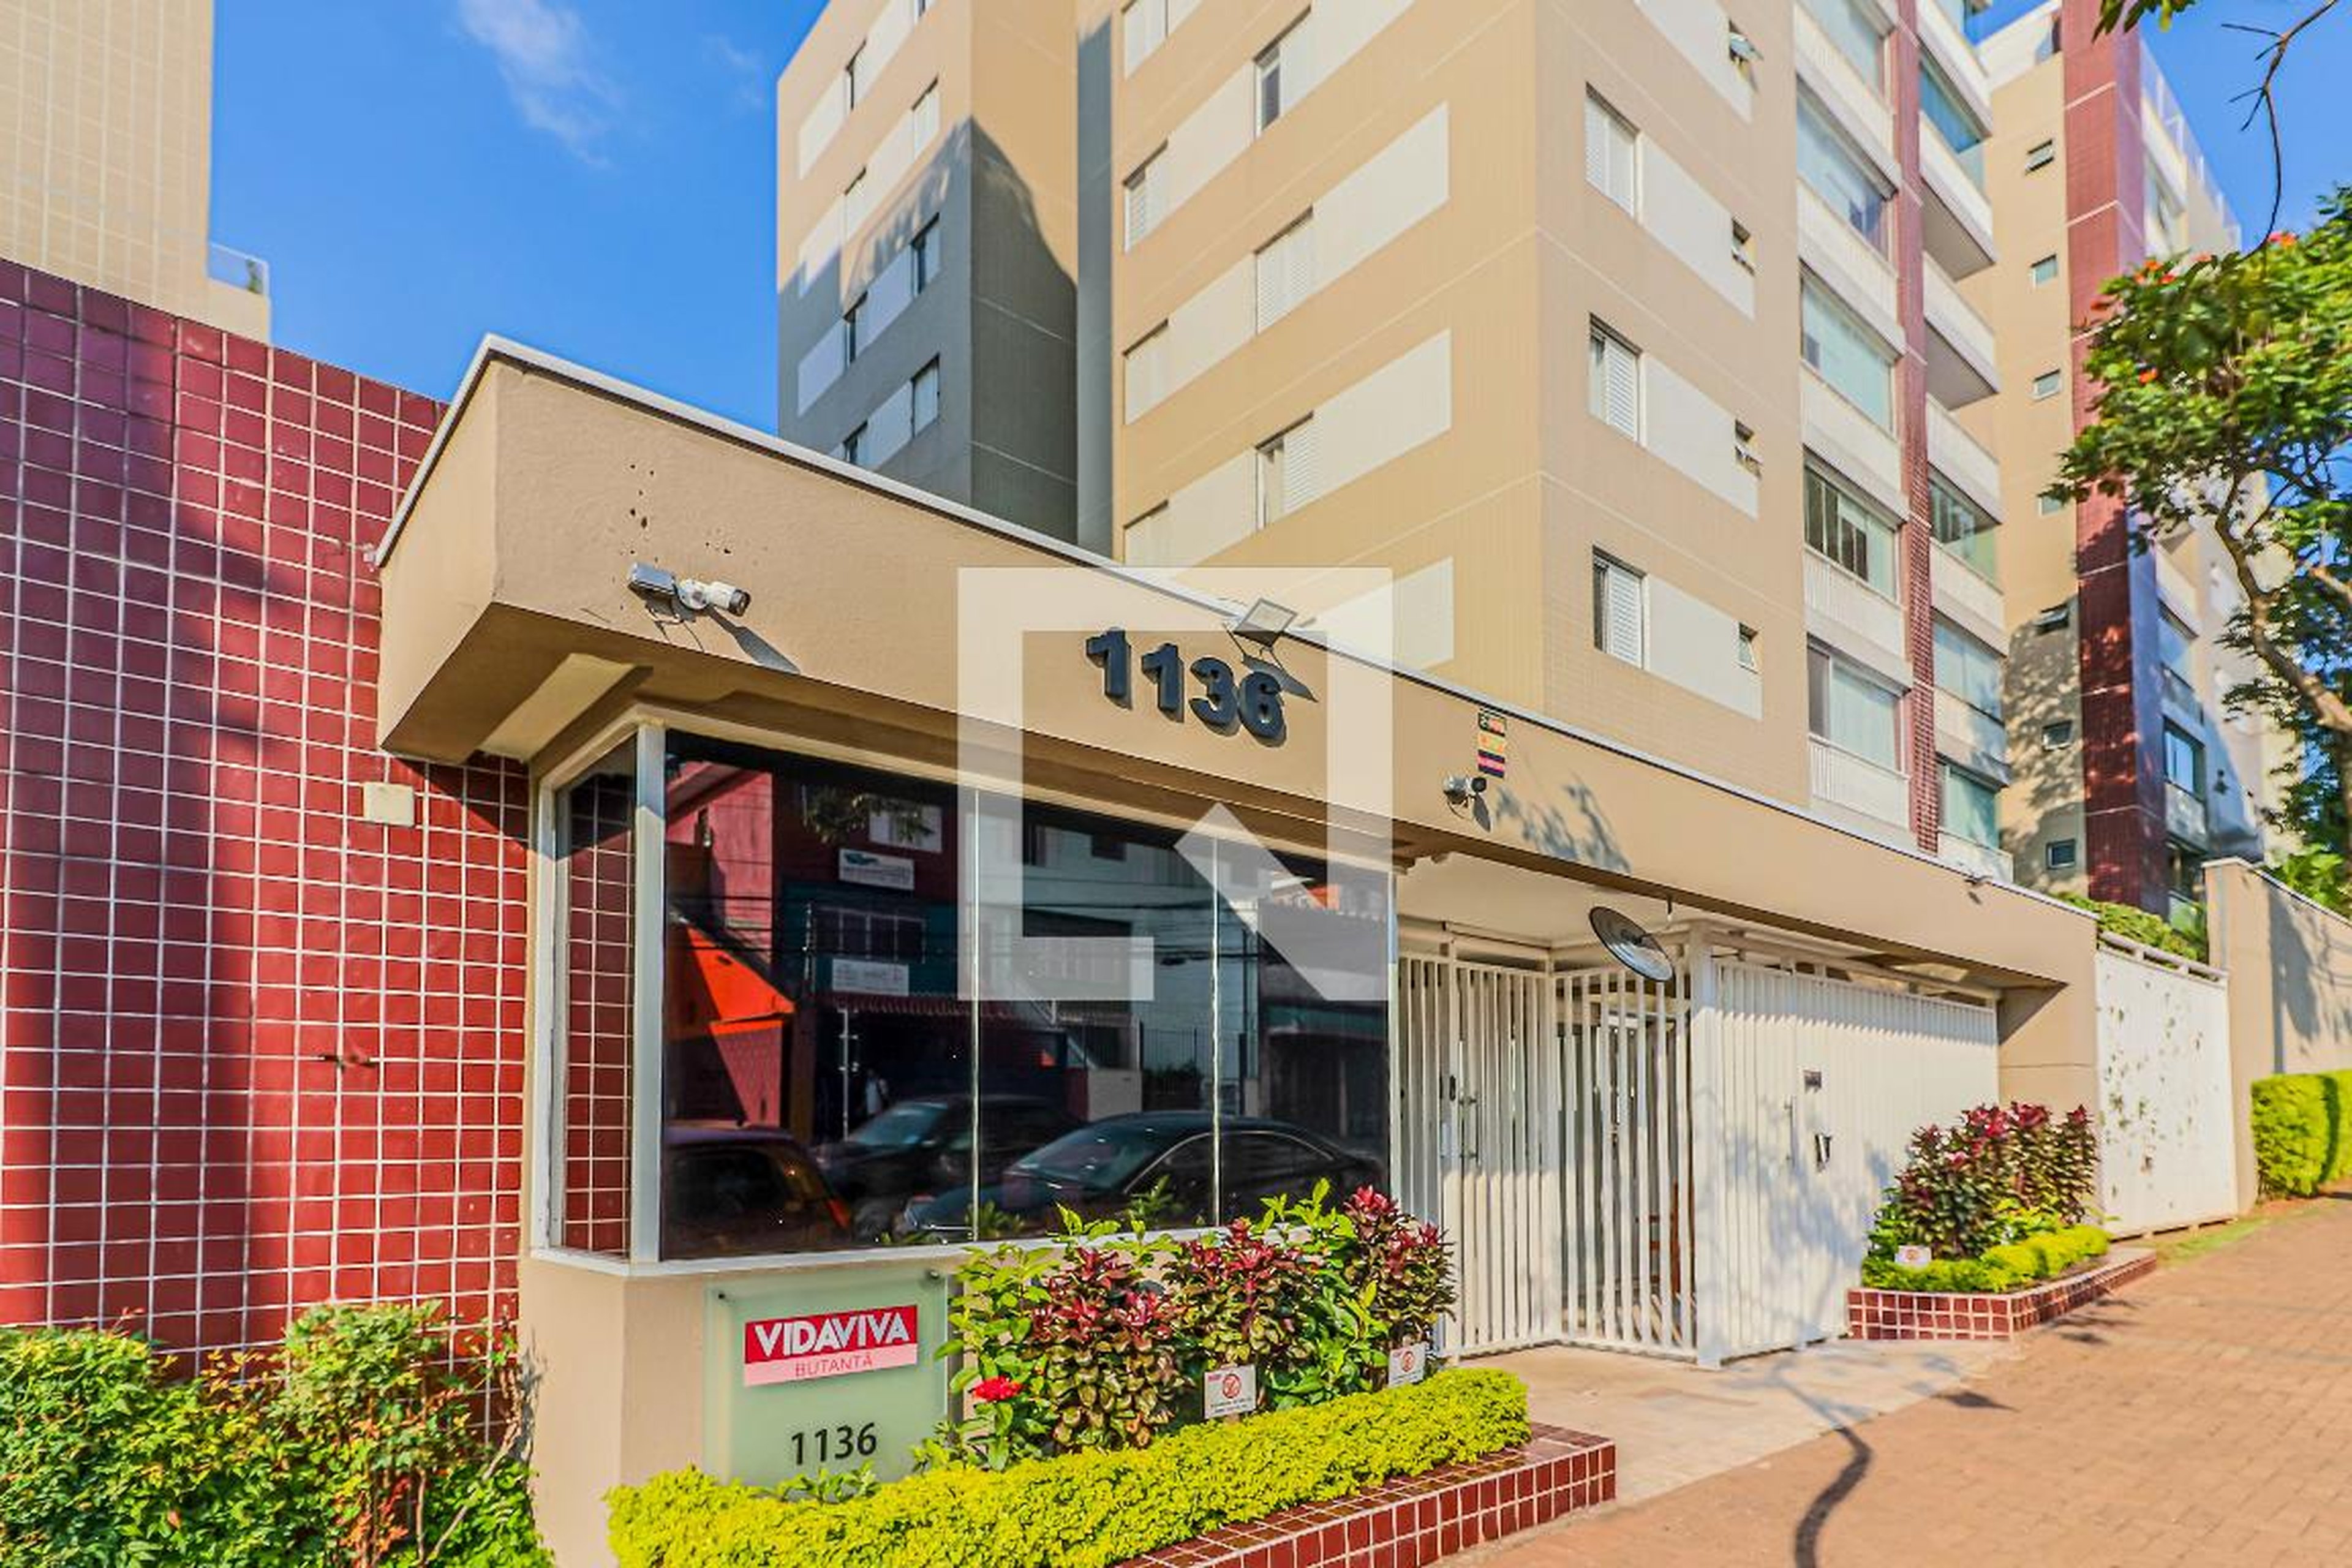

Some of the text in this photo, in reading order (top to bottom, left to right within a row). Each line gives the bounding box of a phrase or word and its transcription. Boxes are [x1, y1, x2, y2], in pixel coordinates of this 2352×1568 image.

[1086, 627, 1287, 742] 1136
[755, 1313, 909, 1356] VIDAVIVA
[796, 1354, 872, 1377] BUTANTÃ
[791, 1422, 877, 1464] 1136
